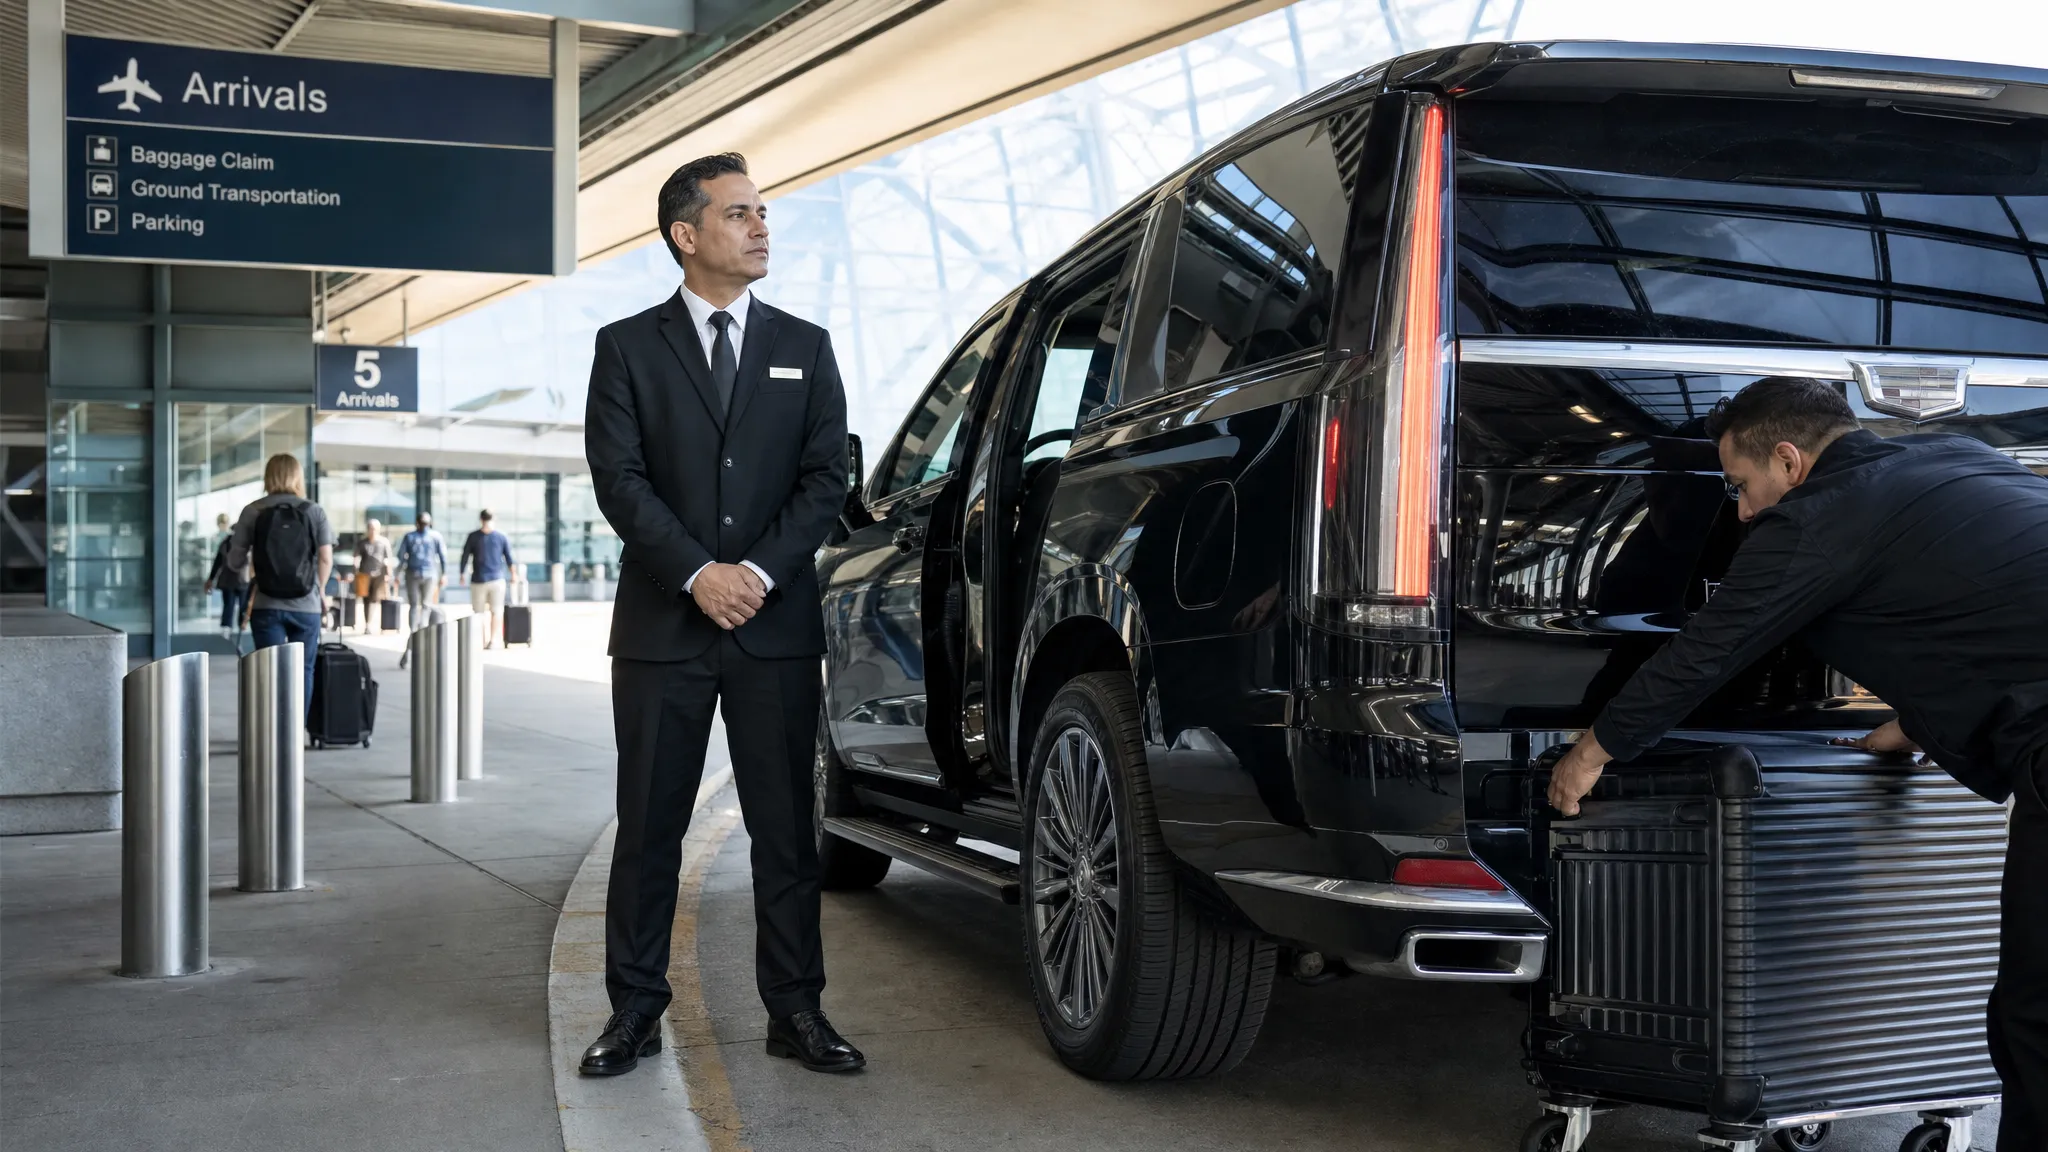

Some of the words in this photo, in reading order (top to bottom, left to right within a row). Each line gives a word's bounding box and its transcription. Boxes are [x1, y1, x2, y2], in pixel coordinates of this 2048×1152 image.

[182, 71, 328, 113] Arrivals
[131, 145, 217, 171] Baggage
[221, 151, 274, 170] Claim
[131, 179, 203, 200] Ground
[208, 183, 341, 206] Transportation
[94, 208, 111, 230] P
[131, 212, 204, 236] Parking
[353, 350, 382, 389] 5
[335, 390, 400, 408] Arrivals
